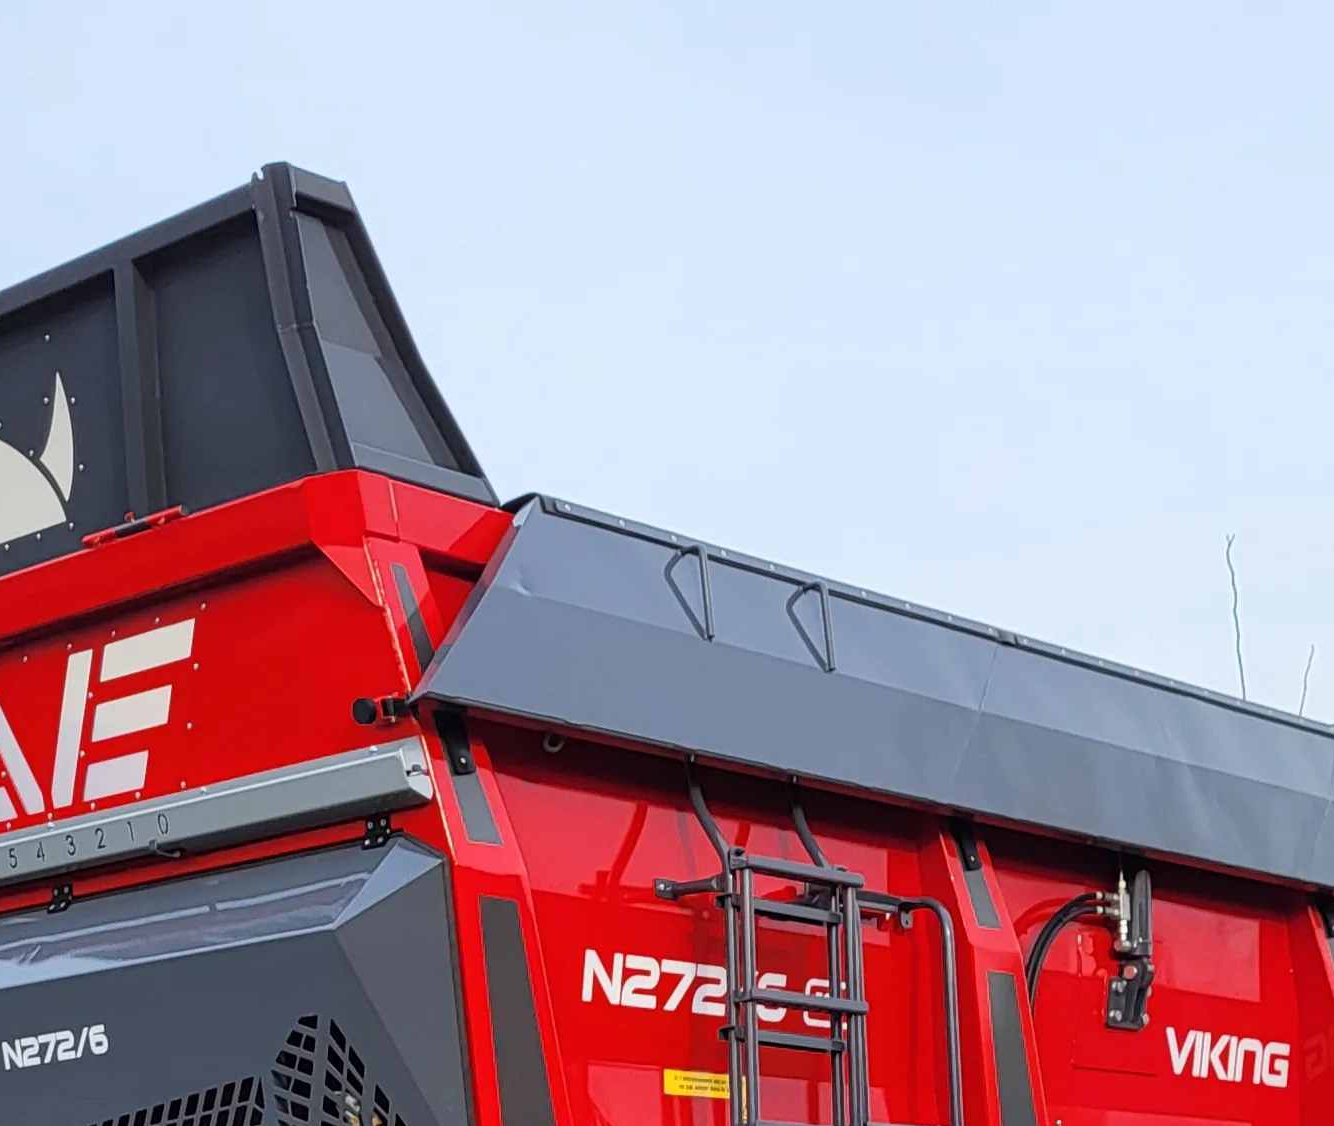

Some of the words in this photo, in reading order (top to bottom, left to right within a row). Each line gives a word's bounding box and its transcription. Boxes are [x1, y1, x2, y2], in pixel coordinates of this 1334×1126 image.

[8, 848, 18, 869] 5
[36, 841, 46, 862] 4
[65, 835, 77, 856] 3
[94, 828, 106, 849] 2
[126, 821, 135, 842] 1
[156, 813, 169, 835] 0
[1, 1023, 109, 1071] N272/6
[1166, 1026, 1290, 1088] VIKING
